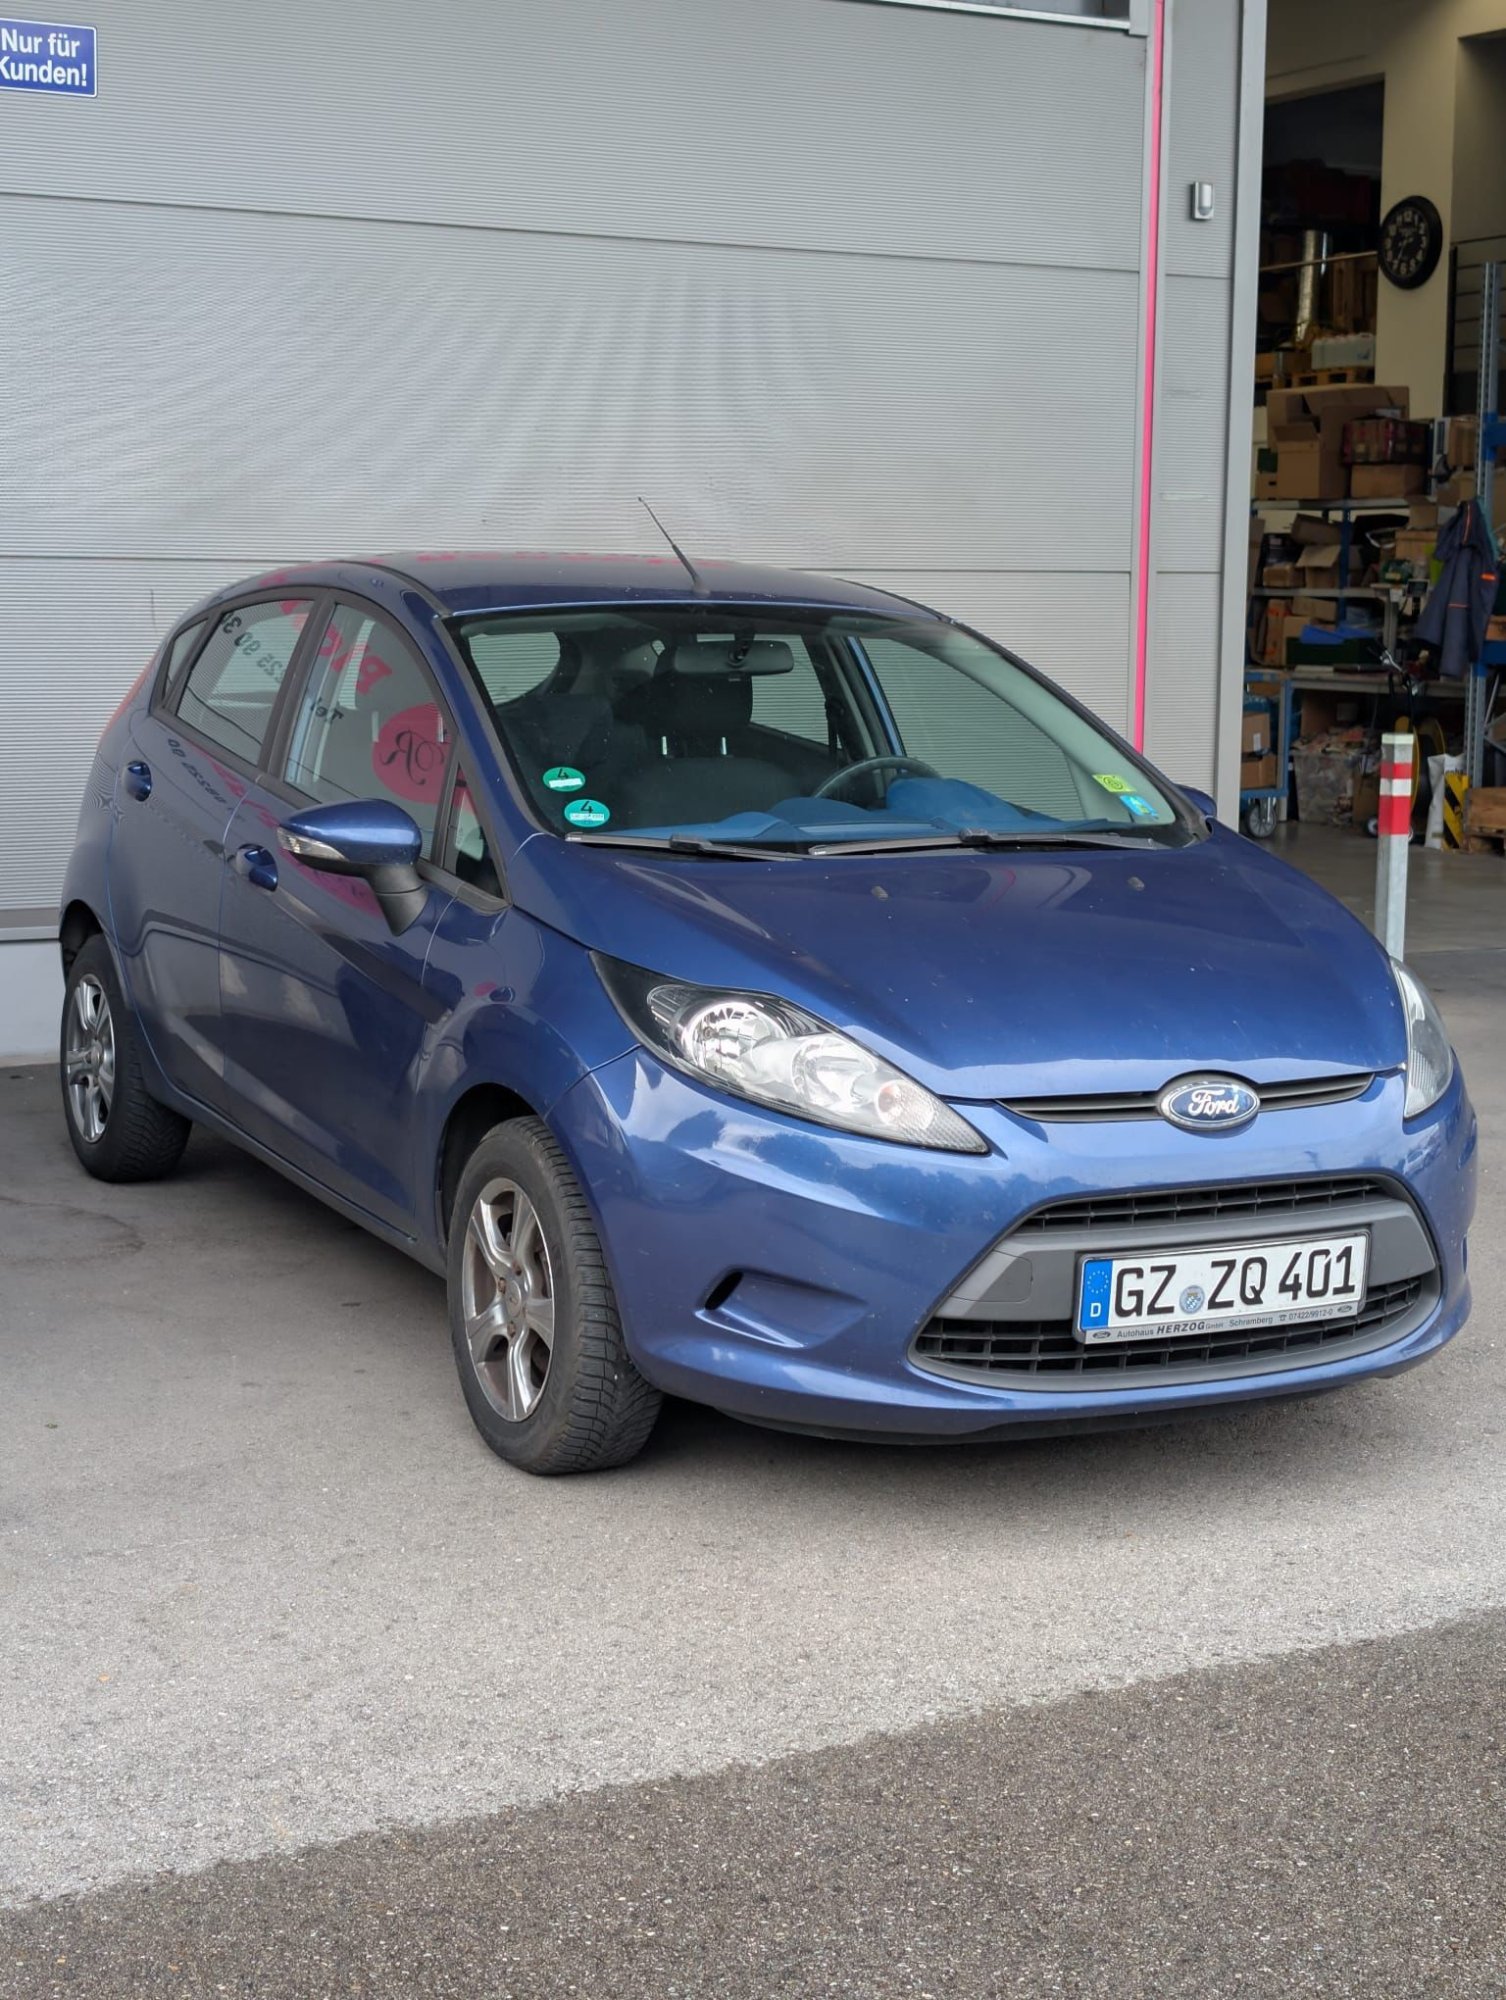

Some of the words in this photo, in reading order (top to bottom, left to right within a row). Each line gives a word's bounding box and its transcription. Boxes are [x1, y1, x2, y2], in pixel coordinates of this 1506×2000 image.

[1, 28, 43, 54] Nur
[48, 33, 80, 57] für
[0, 56, 87, 87] Kunden!
[580, 800, 593, 814] 4
[1187, 1089, 1240, 1119] Ford
[1115, 1264, 1177, 1318] GZ
[1207, 1256, 1267, 1310] ZQ
[1278, 1245, 1356, 1301] 401
[1090, 1302, 1102, 1318] D
[1117, 1328, 1154, 1338] Autohaus
[1156, 1321, 1206, 1335] HERZOG
[1229, 1316, 1273, 1328] Schramberg
